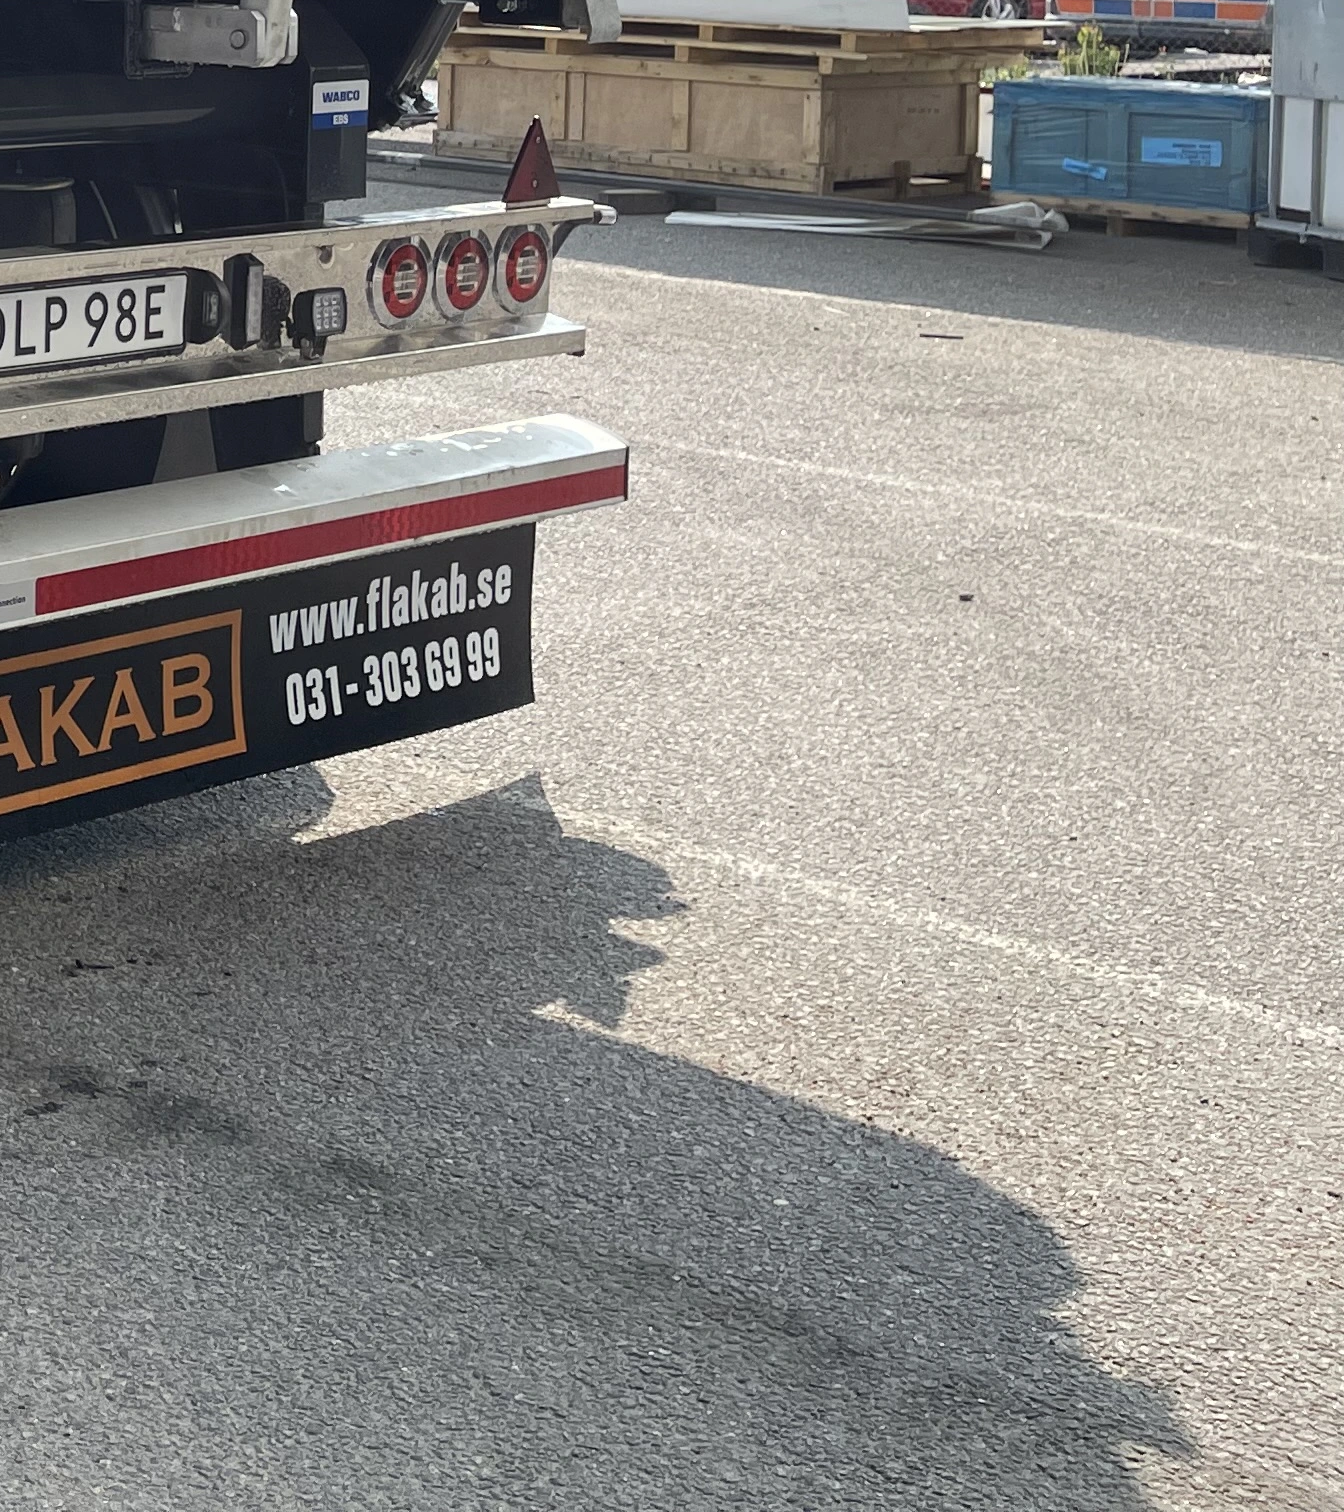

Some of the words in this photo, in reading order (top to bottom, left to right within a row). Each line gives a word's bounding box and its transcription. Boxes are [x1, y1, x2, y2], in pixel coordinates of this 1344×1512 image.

[322, 90, 360, 103] WABCO
[332, 113, 349, 125] EBS
[84, 285, 167, 348] 98E
[269, 561, 512, 654] www.flakab.se
[424, 636, 462, 692] 69
[466, 626, 501, 682] 99
